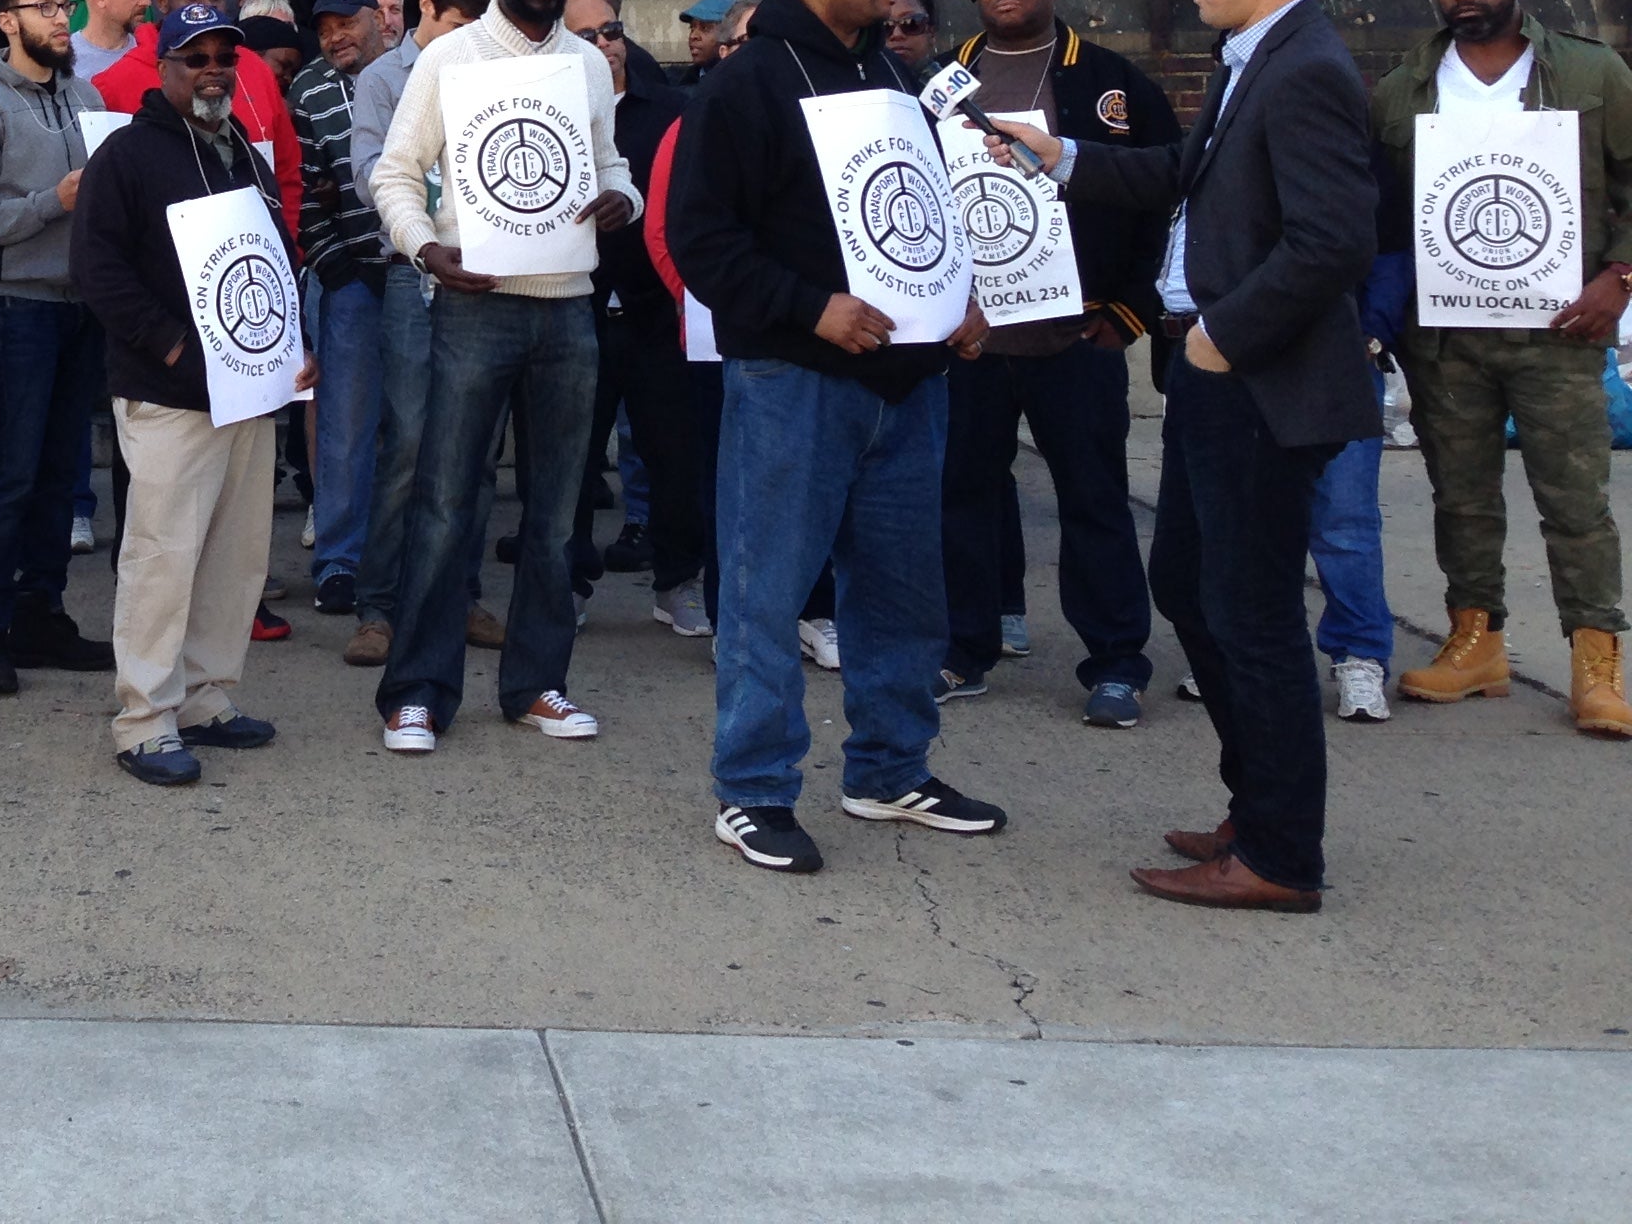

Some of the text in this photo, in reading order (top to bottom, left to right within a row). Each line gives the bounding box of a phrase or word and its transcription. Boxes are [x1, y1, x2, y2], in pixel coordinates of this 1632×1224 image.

[931, 88, 948, 108] 10
[948, 69, 971, 89] 10
[455, 98, 588, 164] ON STRIKE FOR DIGNITY
[488, 128, 564, 177] TRANSPORT WORKERS
[888, 137, 915, 155] FOR
[841, 139, 886, 183] STRIKE
[917, 149, 954, 209] DIGNITY
[972, 151, 996, 166] FO
[1422, 153, 1575, 216] ON STRIKE FOR DIGNITY
[456, 172, 591, 236] AND JUSTICE ON THE JOB
[837, 188, 850, 213] ON
[870, 171, 940, 229] TRANSPORT WORKERS
[990, 181, 1030, 222] WORKERS
[1455, 183, 1543, 232] TRANSPORT WORKERS
[197, 233, 294, 309] ON STRIKE FOR DIGNITY
[842, 225, 964, 298] AND JUSTICE ON THE JOB
[1007, 268, 1028, 285] ON
[1028, 248, 1054, 271] THE
[1047, 217, 1063, 245] JOB
[1420, 228, 1576, 291] AND JUSTICE ON THE JOB
[224, 265, 282, 322] TRANSPORT WORKERS
[982, 285, 1070, 308] LOCAL 234
[1429, 294, 1571, 311] TWU LOCAL 234
[201, 301, 297, 377] AND JUSTICE ON THE JOB
